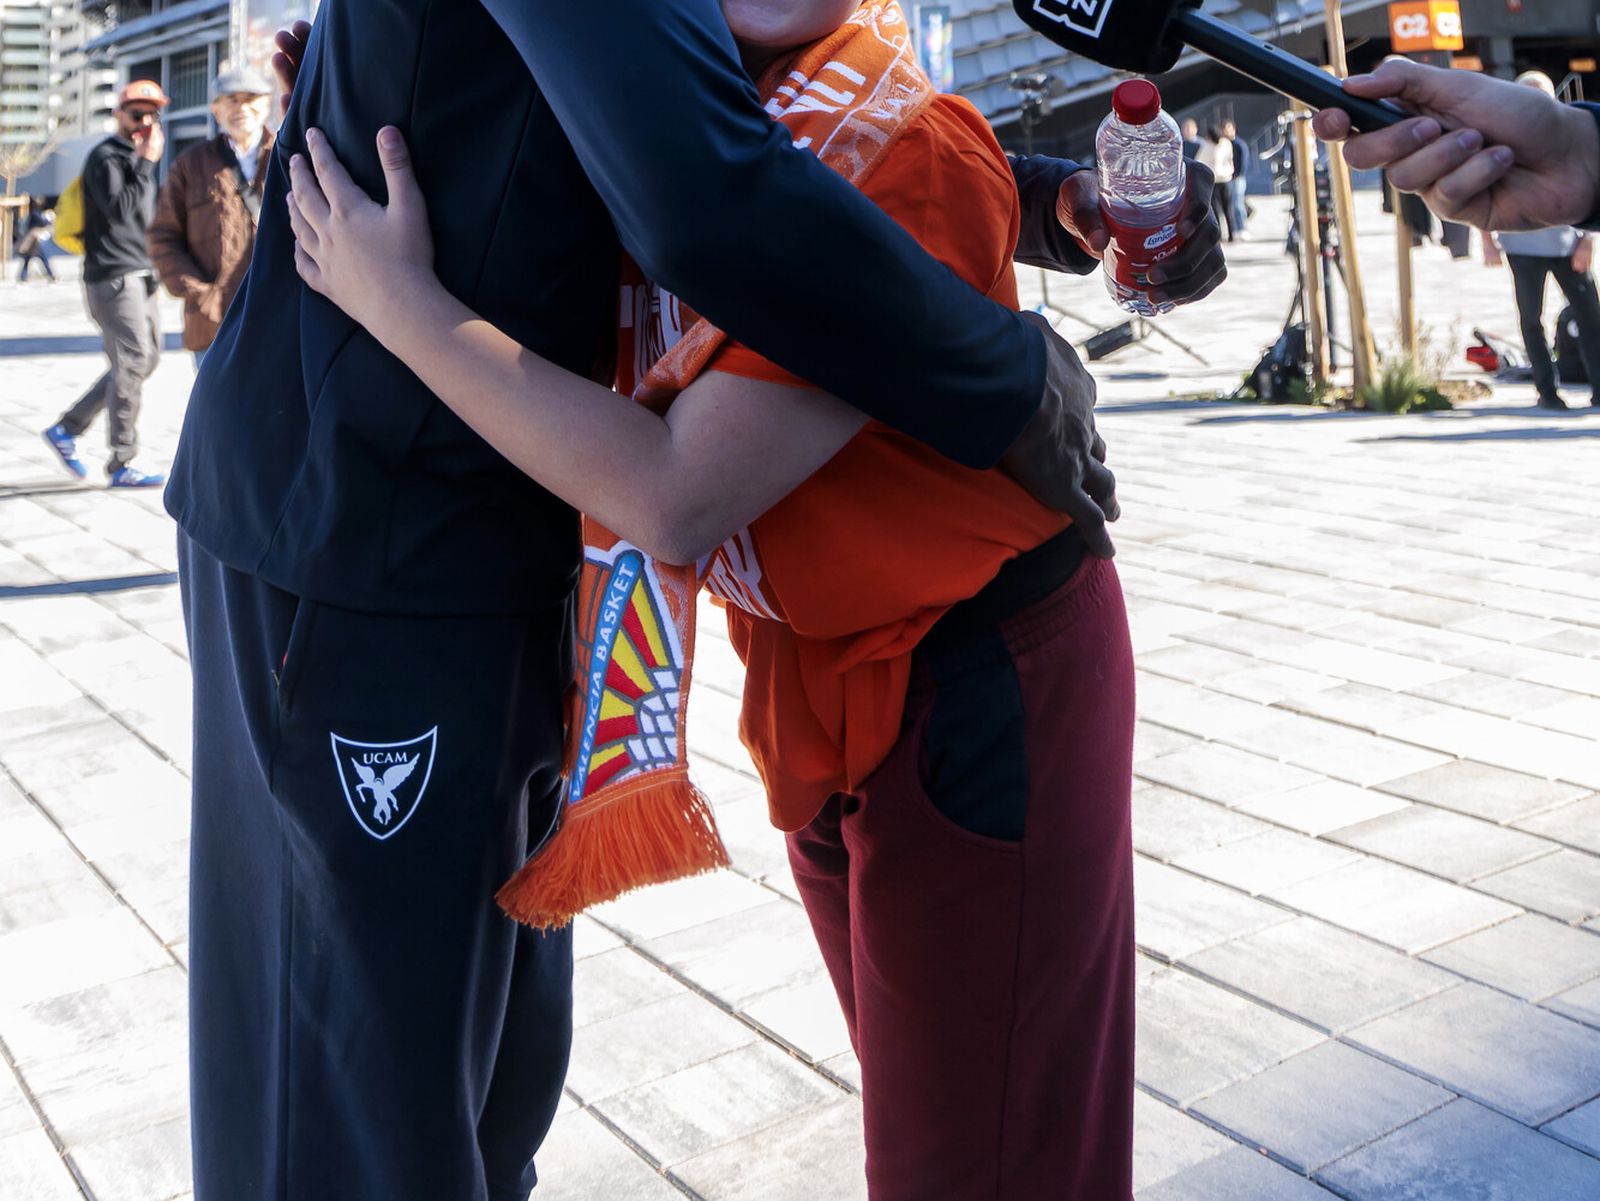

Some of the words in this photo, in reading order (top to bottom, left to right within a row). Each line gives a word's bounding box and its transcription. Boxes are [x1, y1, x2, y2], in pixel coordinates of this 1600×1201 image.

[1393, 12, 1430, 39] C2
[571, 671, 603, 799] VALENCIA
[596, 562, 635, 662] BASKET
[362, 751, 408, 765] UCAM
